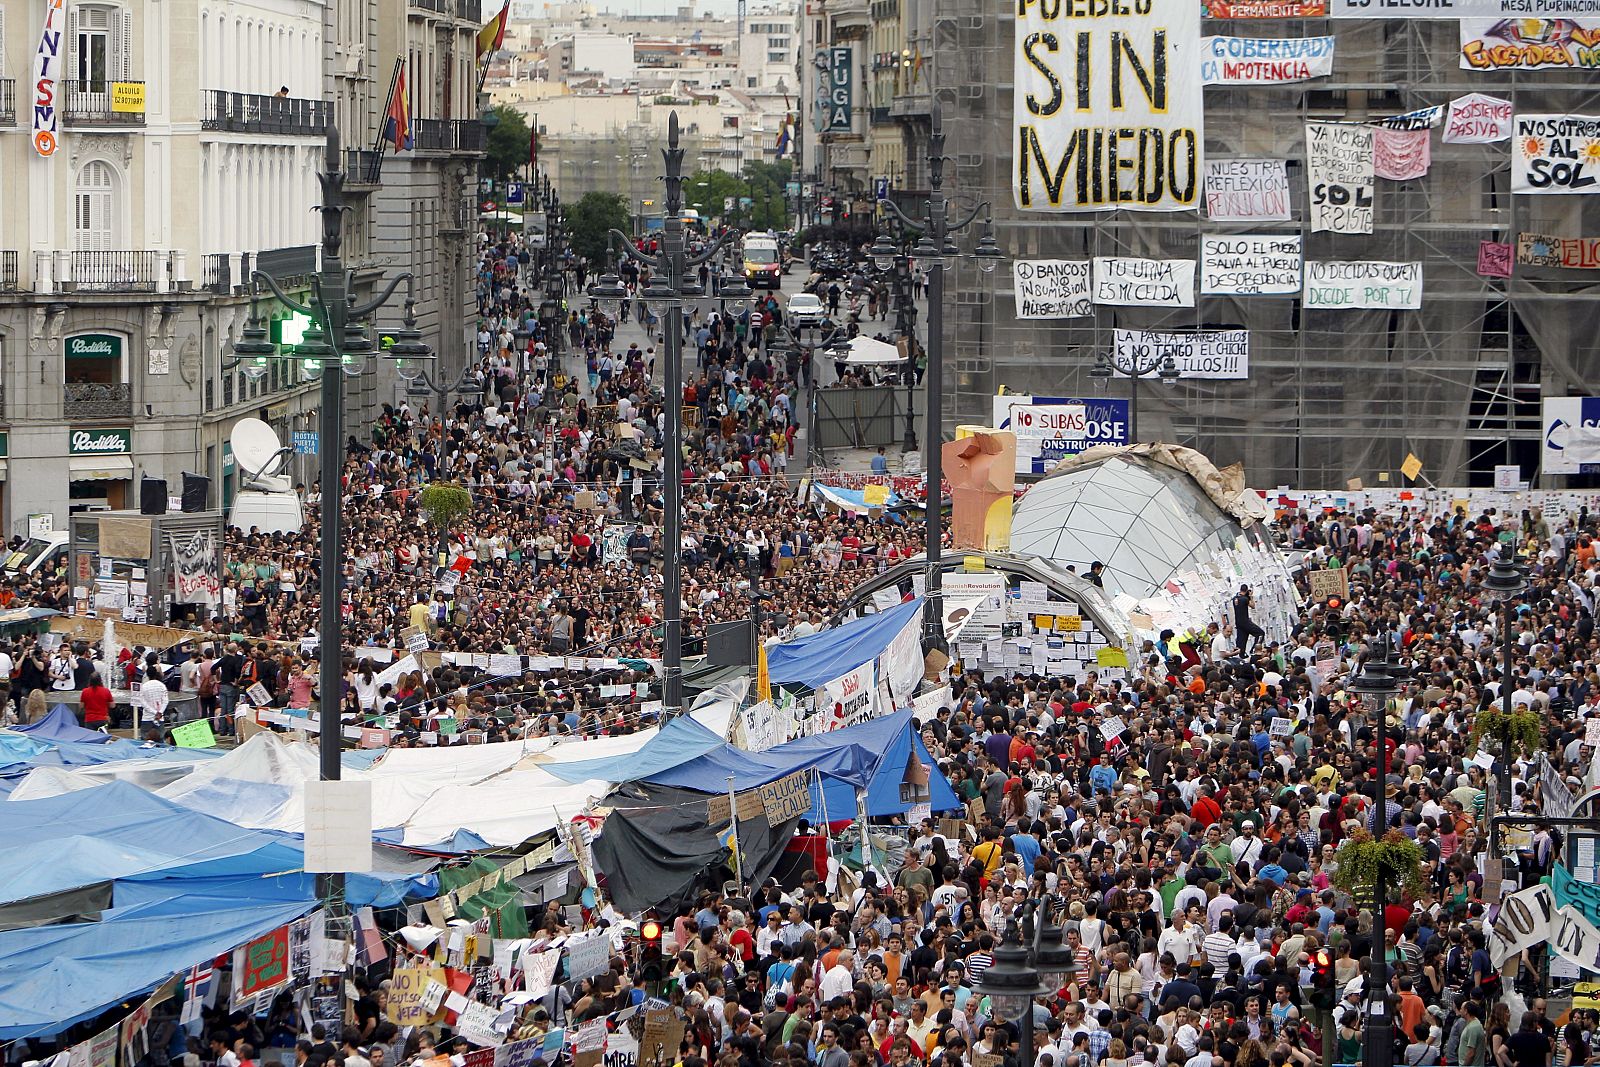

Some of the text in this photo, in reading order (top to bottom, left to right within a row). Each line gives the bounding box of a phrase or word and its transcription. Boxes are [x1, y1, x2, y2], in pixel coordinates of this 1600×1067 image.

[1230, 4, 1301, 17] PERMANENTE
[1501, 0, 1532, 12] MESA
[1023, 30, 1168, 116] SIN
[832, 49, 849, 124] FUGA
[1310, 126, 1328, 140] YA
[1333, 129, 1349, 145] NO
[1548, 139, 1578, 159] AL
[1019, 126, 1197, 206] MIEDO
[1211, 162, 1283, 175] NUESTRA
[1527, 158, 1597, 188] SOL
[1313, 184, 1373, 207] SOL
[1206, 241, 1248, 255] SOLO
[1253, 242, 1267, 254] EL
[1036, 263, 1088, 279] BANCOS
[1102, 259, 1127, 277] TU
[1206, 258, 1243, 268] SALVA
[1246, 257, 1261, 269] AL
[1309, 264, 1325, 280] NO
[1329, 264, 1379, 280] DECIDAS
[1099, 283, 1115, 300] ES
[1134, 284, 1181, 304] CELDA
[1308, 286, 1412, 306] DECIDE POR TI
[1116, 330, 1134, 342] LA
[72, 339, 112, 354] Rodilla
[1118, 344, 1125, 355] K
[1132, 345, 1150, 357] NO
[1200, 344, 1215, 355] EL
[1017, 412, 1032, 427] NO
[72, 431, 126, 452] Rodilla
[294, 432, 318, 440] HOSTAL
[303, 446, 317, 454] SOL
[763, 775, 807, 801] LA LUCHA
[783, 790, 811, 818] CALLE
